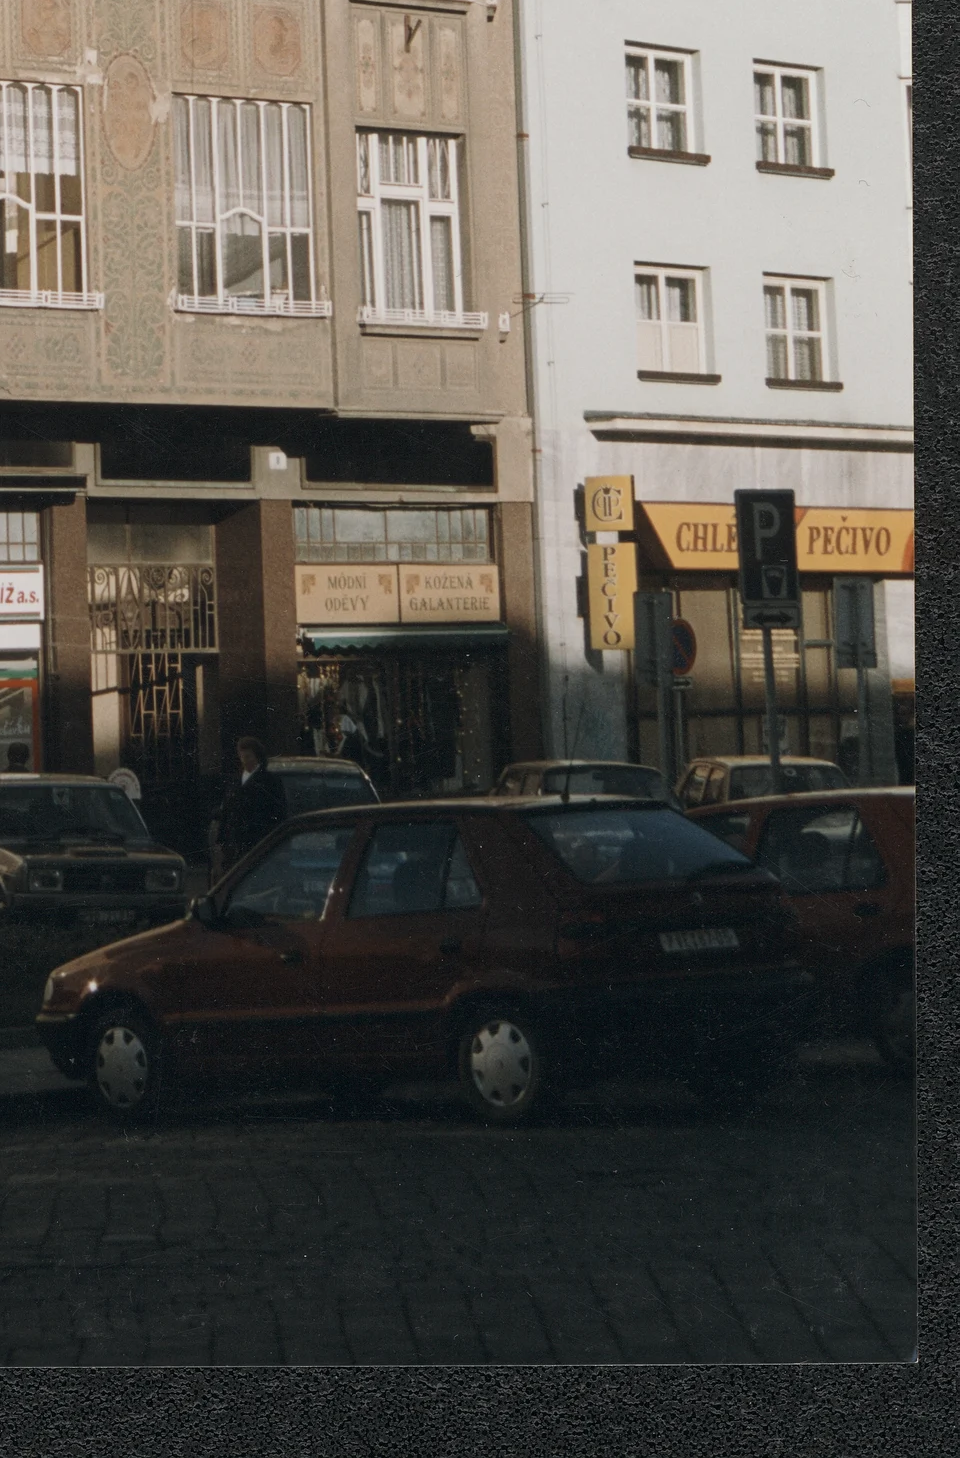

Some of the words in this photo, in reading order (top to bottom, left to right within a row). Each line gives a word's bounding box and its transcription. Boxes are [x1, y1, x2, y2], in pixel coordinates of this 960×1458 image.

[675, 513, 739, 554] CHLÉ
[806, 516, 892, 557] PEČIVO
[752, 501, 781, 561] P
[424, 571, 474, 590] KOŽENÁ
[16, 590, 40, 604] a.s.
[324, 592, 370, 612] ODĚVY
[409, 596, 491, 611] GALANTERIE
[601, 545, 622, 647] PEČIVO
